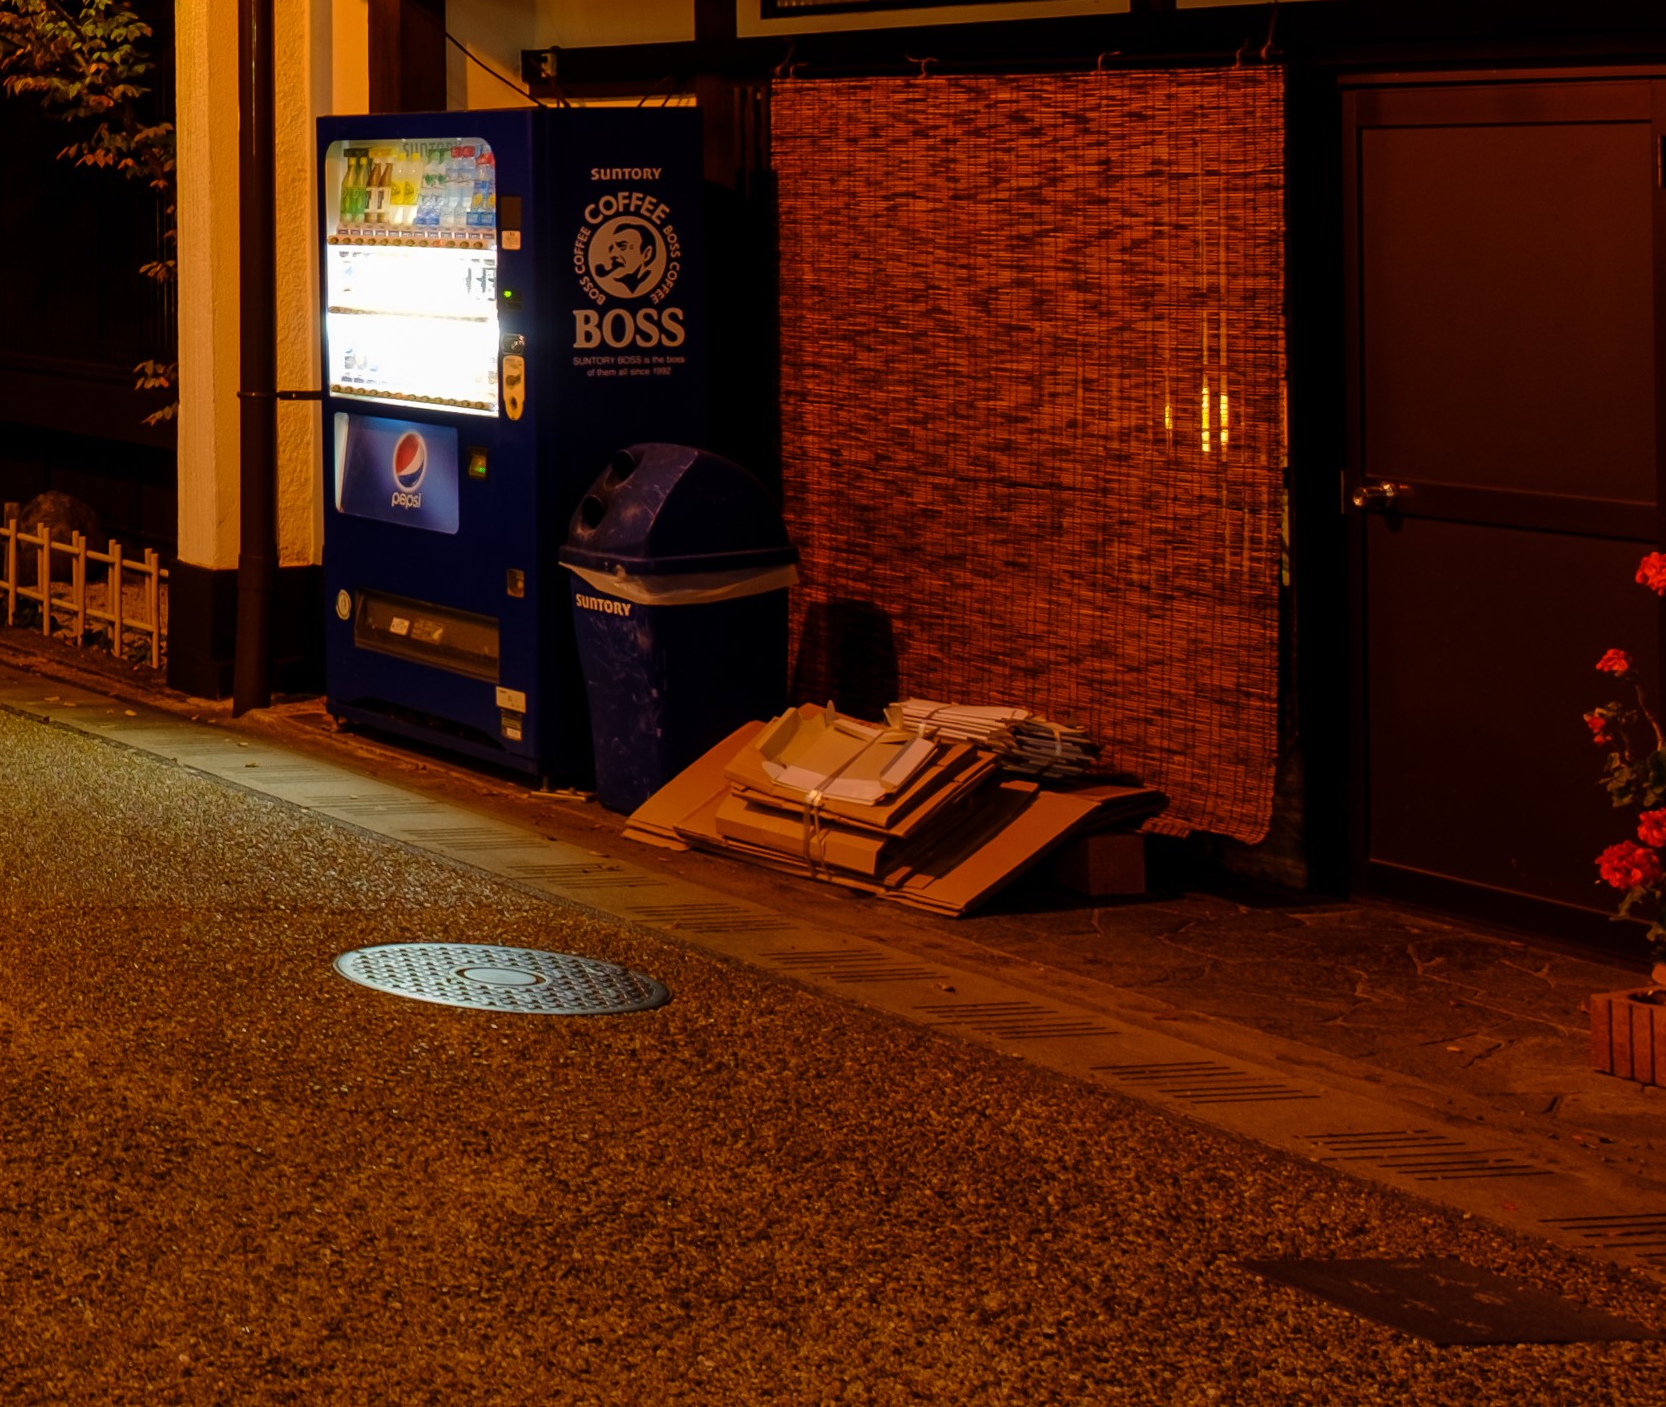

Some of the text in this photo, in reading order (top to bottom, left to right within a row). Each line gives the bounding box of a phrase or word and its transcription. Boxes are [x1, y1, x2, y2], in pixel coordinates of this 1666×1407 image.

[591, 167, 663, 181] SUNTORY
[584, 191, 671, 225] COFFEE
[573, 226, 607, 306] BOSS COFFEE
[650, 225, 682, 306] BOSS COFFEE
[572, 307, 686, 349] BOSS
[572, 356, 616, 367] SUNTORY
[617, 356, 642, 366] BOSS
[652, 356, 665, 365] the
[666, 355, 686, 365] boss
[586, 368, 596, 378] of
[618, 367, 629, 377] all
[630, 367, 651, 377] since
[652, 366, 672, 376] 1992
[391, 492, 422, 510] pepsi
[575, 593, 631, 617] SUNTORY
